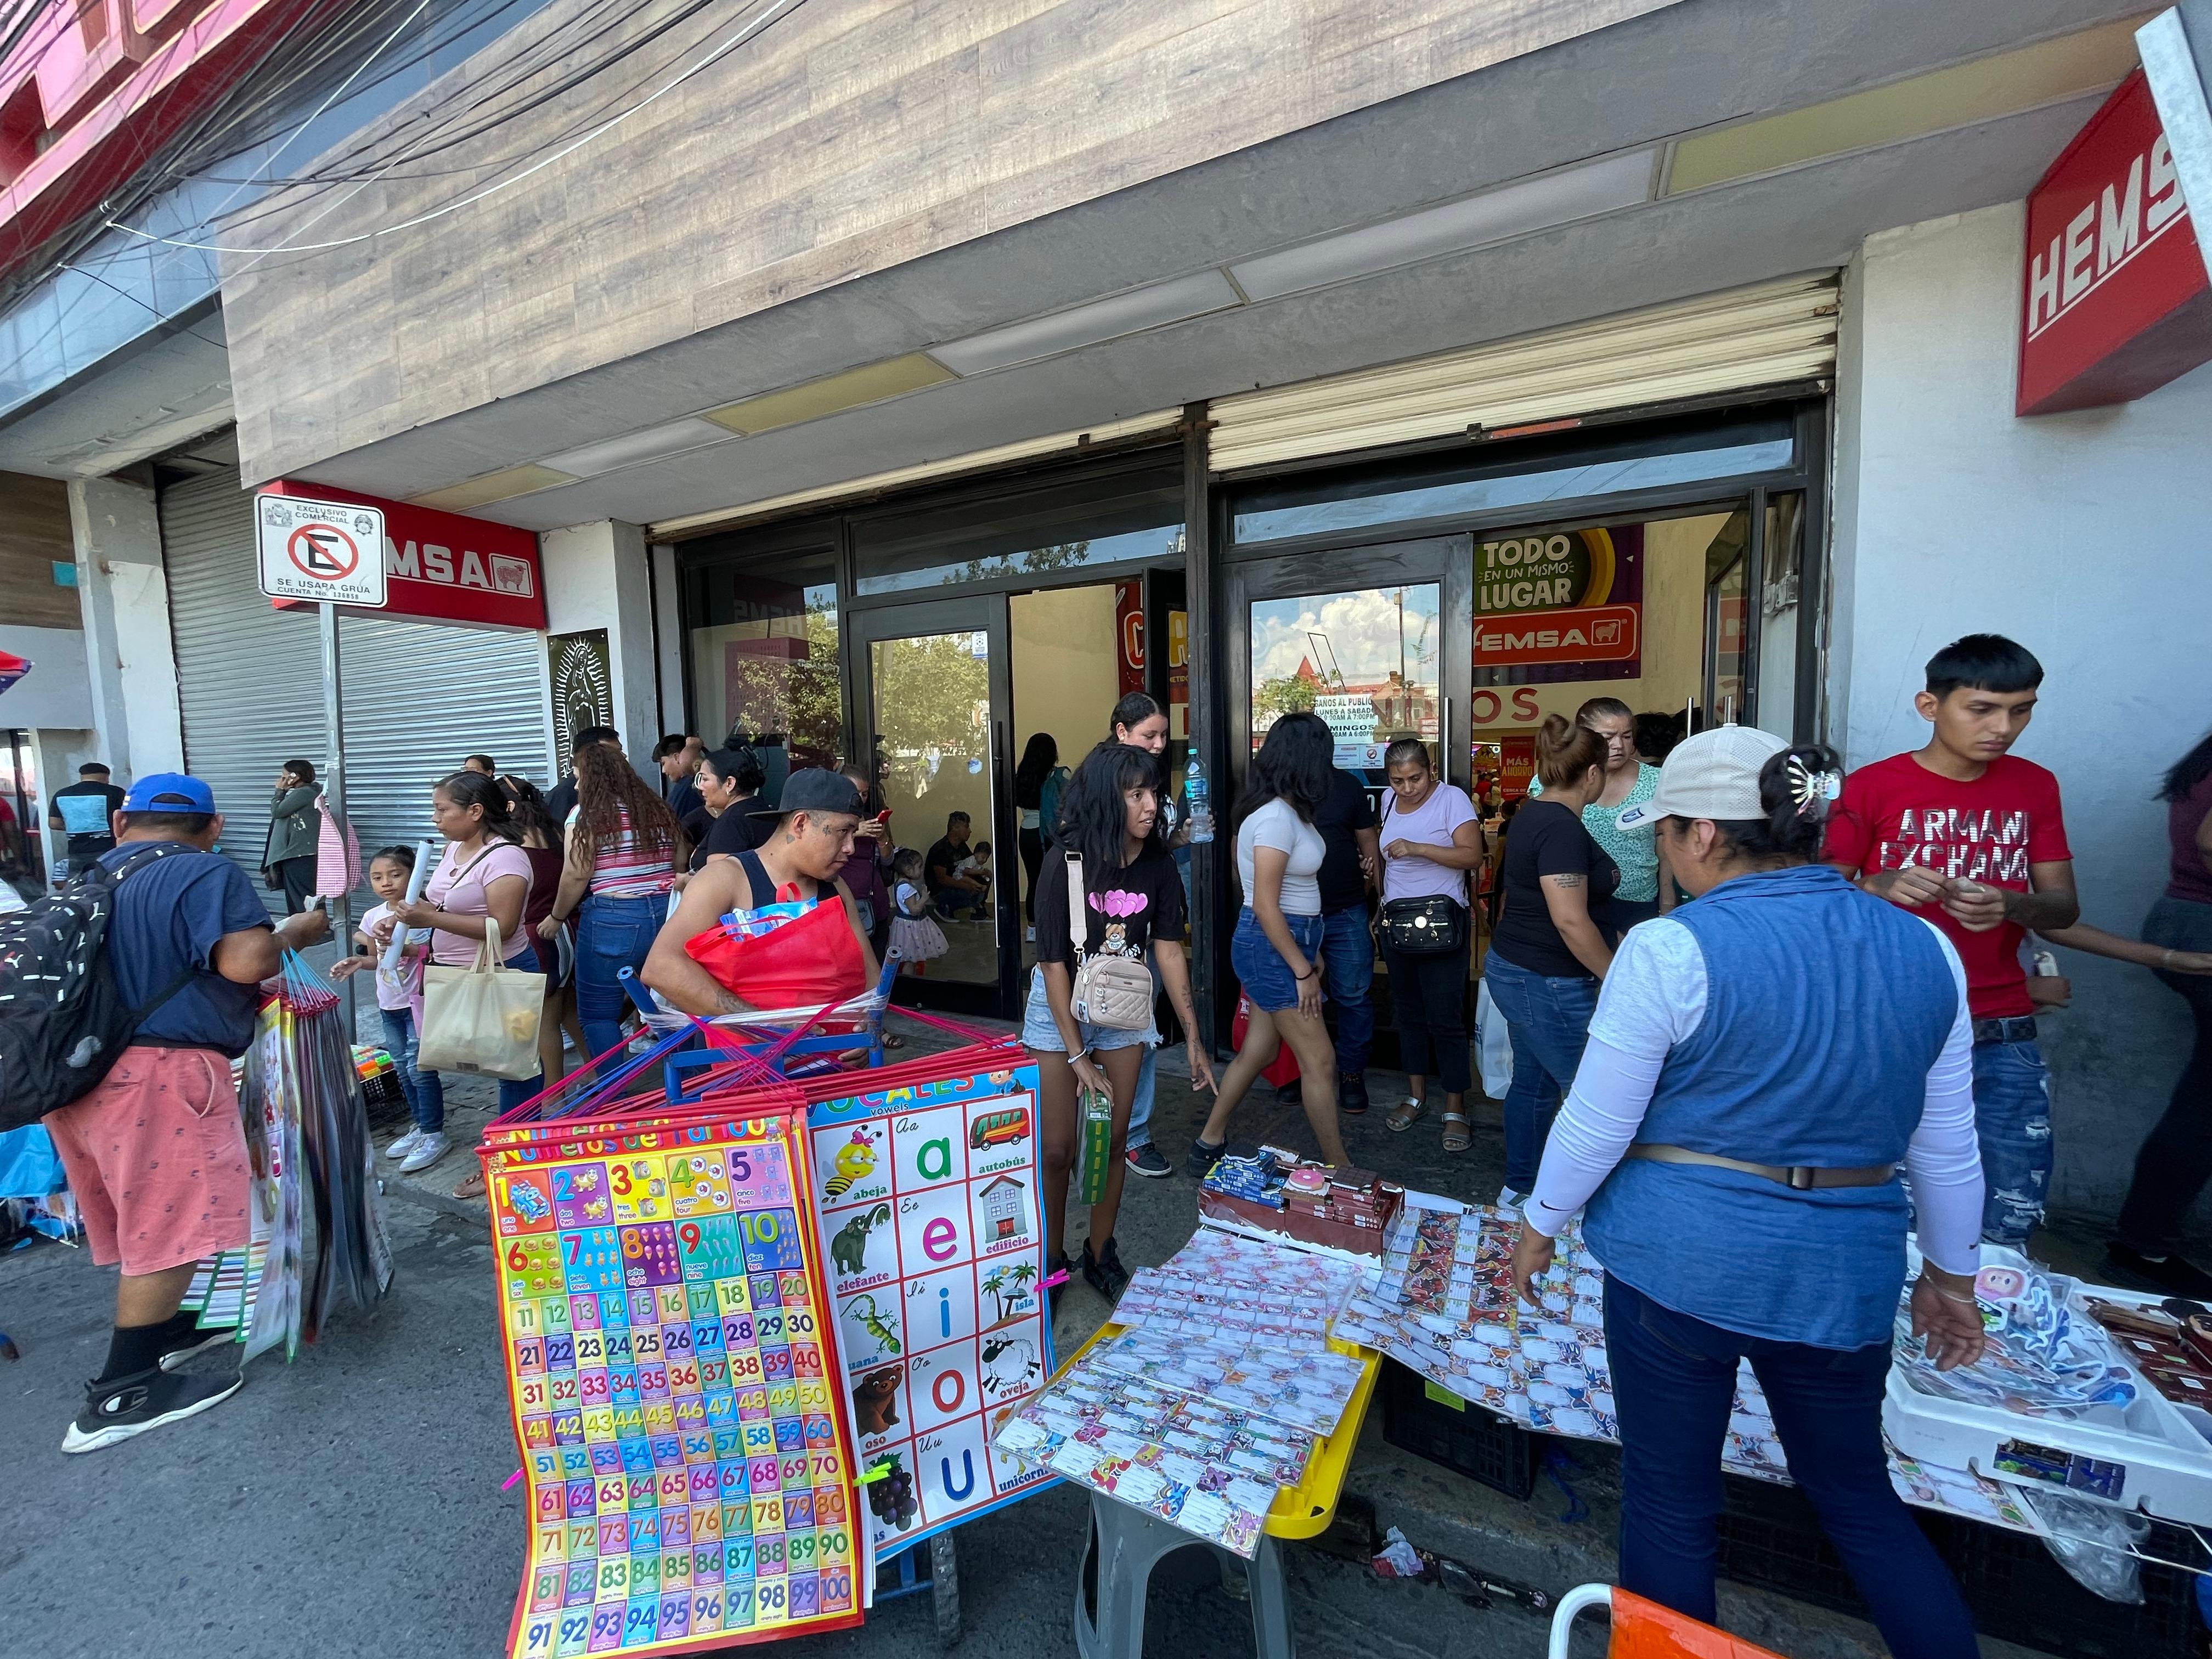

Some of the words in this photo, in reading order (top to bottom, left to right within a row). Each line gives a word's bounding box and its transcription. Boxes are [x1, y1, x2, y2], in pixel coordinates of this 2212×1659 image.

[2030, 132, 2188, 334] HEMS
[295, 512, 350, 523] COMERCIAL
[297, 505, 347, 517] EXCLUSIVO
[387, 537, 492, 589] MSA
[1483, 534, 1571, 568] TODO
[1484, 567, 1502, 582] EN
[1506, 566, 1525, 579] UN
[1528, 562, 1570, 578] MISMO
[1480, 578, 1572, 611] LUGAR
[1474, 623, 1588, 653] EMSA
[1502, 766, 1533, 776] AHORRO
[1506, 755, 1529, 765] MÁS
[870, 1102, 910, 1116] vowels
[917, 1137, 952, 1181] a
[495, 1177, 510, 1207] 1
[554, 1171, 574, 1201] 2
[610, 1165, 632, 1195] 3
[670, 1158, 694, 1188] 4
[732, 1152, 752, 1181] 5
[853, 1185, 888, 1201] abeja
[506, 1241, 529, 1272] 6
[563, 1235, 583, 1266] 7
[621, 1229, 644, 1259] 8
[679, 1223, 700, 1255] 9
[741, 1213, 778, 1246] 10
[922, 1217, 958, 1262] e
[986, 1235, 1029, 1255] edificio
[629, 1277, 647, 1286] eight
[837, 1271, 890, 1293] elefante
[518, 1306, 532, 1327] 11
[545, 1303, 567, 1323] 12
[574, 1299, 595, 1320] 13
[602, 1295, 624, 1317] 14
[634, 1292, 652, 1313] 15
[661, 1289, 683, 1310] 16
[691, 1288, 710, 1309] 17
[721, 1283, 743, 1305] 18
[753, 1279, 773, 1300] 19
[781, 1276, 806, 1297] 20
[939, 1287, 950, 1339] i
[1014, 1297, 1035, 1312] isla
[520, 1347, 540, 1365] 21
[549, 1342, 572, 1362] 22
[578, 1339, 601, 1357] 23
[607, 1336, 631, 1355] 24
[636, 1334, 659, 1353] 25
[665, 1330, 690, 1350] 26
[696, 1326, 719, 1346] 27
[726, 1322, 752, 1341] 28
[758, 1317, 782, 1336] 29
[788, 1314, 812, 1333] 30
[848, 1355, 879, 1371] uana
[1000, 1381, 1029, 1398] oveja
[527, 1420, 549, 1440] 41
[555, 1415, 582, 1435] 42
[585, 1412, 612, 1432] 43
[614, 1409, 643, 1429] 44
[646, 1406, 673, 1425] 45
[677, 1401, 704, 1420] 46
[708, 1396, 733, 1415] 47
[738, 1391, 765, 1410] 48
[769, 1387, 795, 1407] 49
[800, 1385, 826, 1404] 50
[865, 1435, 887, 1450] oso
[541, 1489, 561, 1511] 61
[569, 1487, 594, 1506] 62
[599, 1481, 624, 1502] 63
[629, 1479, 656, 1498] 64
[661, 1475, 685, 1494] 65
[691, 1471, 716, 1490] 66
[722, 1466, 745, 1486] 67
[752, 1462, 777, 1482] 68
[783, 1458, 807, 1478] 69
[813, 1455, 838, 1474] 70
[528, 1626, 551, 1650] 91
[560, 1619, 588, 1644] 92
[594, 1612, 623, 1638] 93
[627, 1606, 656, 1632] 94
[662, 1601, 689, 1626] 95
[694, 1597, 721, 1620] 96
[727, 1592, 752, 1615] 97
[758, 1587, 785, 1609] 98
[790, 1581, 816, 1604] 99
[822, 1577, 851, 1600] 100
